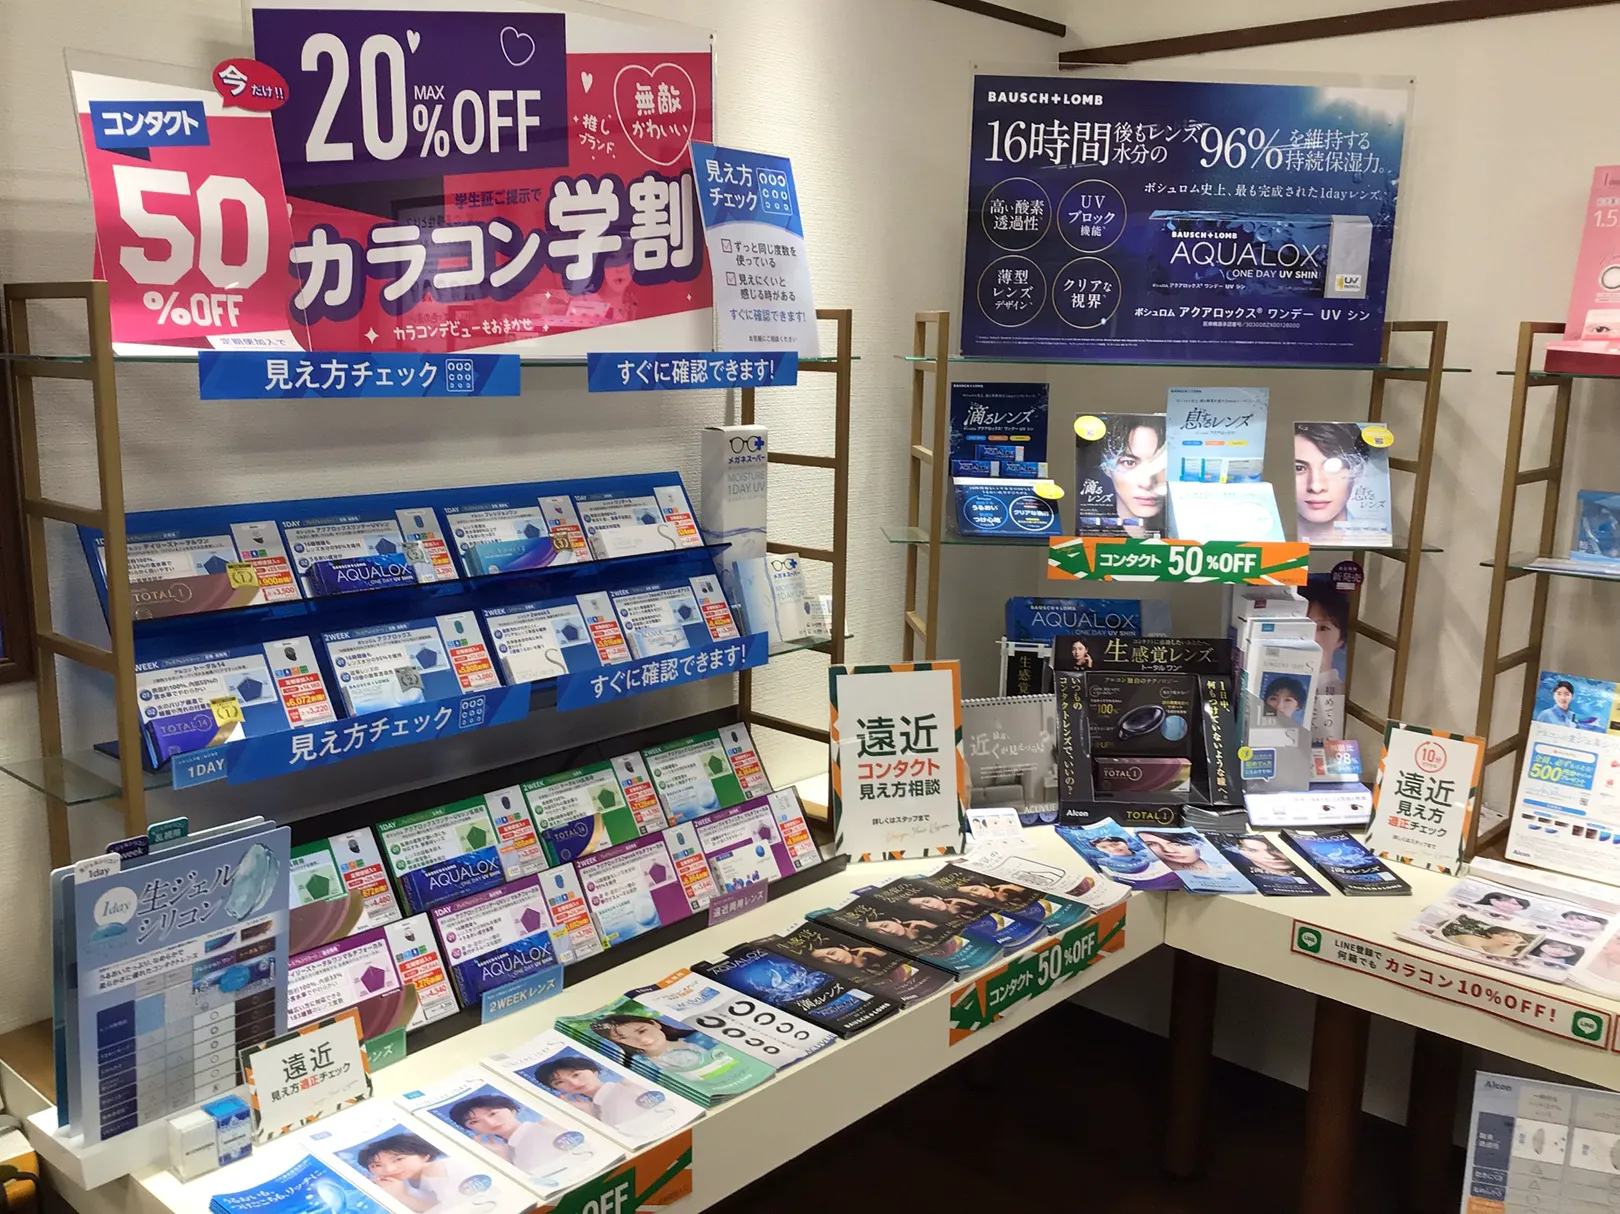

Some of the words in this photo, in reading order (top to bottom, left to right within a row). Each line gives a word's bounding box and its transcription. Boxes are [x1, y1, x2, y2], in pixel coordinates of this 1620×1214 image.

[414, 84, 445, 100] MAX
[634, 81, 682, 115] 無敵
[988, 91, 1103, 106] BAUSCH+LOMB
[101, 111, 200, 137] コンタクト
[583, 115, 610, 136] 推し
[632, 120, 688, 139] かわいい
[1113, 120, 1203, 144] 後もレンズ
[579, 133, 615, 154] ブランド
[985, 119, 1112, 166] 16時間
[1289, 128, 1371, 150] を維持する
[1112, 144, 1168, 164] 水分の
[1200, 126, 1283, 170] 96%
[1285, 150, 1386, 174] 持続保湿力。
[706, 159, 753, 188] 見え方
[455, 188, 541, 209] 学生証ご提示で
[709, 187, 758, 211] チェック
[990, 199, 1044, 215] 高い酸素
[1081, 195, 1106, 209] UV
[112, 163, 270, 290] 50
[993, 215, 1039, 231] 透過性
[1068, 211, 1116, 225] ブロック
[1080, 225, 1102, 237] 機能
[1171, 231, 1238, 239] BAUSCH+LOMB
[289, 174, 693, 310] カラコン学割
[734, 241, 797, 257] ずっと同じ度数を
[736, 254, 776, 268] 使っている
[1170, 241, 1321, 267] AQUALOX
[739, 273, 786, 287] 見えにくいと
[997, 269, 1029, 285] 薄型
[1232, 269, 1253, 279] ONE
[1256, 269, 1277, 279] DAY
[1279, 270, 1294, 279] UV
[1295, 270, 1318, 279] SHIN
[993, 286, 1033, 299] レンズ
[1063, 278, 1112, 293] クリアな
[1225, 282, 1235, 290] UV
[740, 288, 796, 302] 感じる時がある
[1071, 293, 1102, 309] 視界
[143, 290, 244, 328] %OFF
[995, 300, 1028, 311] デザイン
[1134, 307, 1176, 318] ボシュロム
[1268, 307, 1314, 320] ワンデー
[1320, 309, 1342, 321] UV
[1347, 310, 1371, 321] シン
[393, 317, 533, 343] カラコンデビューもおまかせ
[264, 357, 439, 391] 見え方チェック
[617, 356, 775, 385] すぐに確認できます!
[963, 403, 1035, 427] 滴るレンズ
[728, 454, 765, 465] メガネスーパー
[727, 472, 765, 482] MOISTURE
[728, 483, 751, 496] 1DAY
[753, 481, 766, 494] UV
[282, 520, 300, 529] 1DAY
[1100, 552, 1162, 569] コンタクト
[337, 562, 412, 583] AQUALOX
[610, 590, 630, 598] 2WEEK
[484, 607, 506, 617] 2WEEK
[1031, 612, 1136, 629] AQUALOX
[324, 632, 350, 642] 2WEEK
[1103, 638, 1214, 664] 生感覚レンズ
[591, 644, 746, 699] すぐに確認できます!
[1141, 664, 1166, 672] トータル
[1167, 664, 1182, 672] ワン
[1071, 677, 1083, 710] いつもの
[160, 721, 196, 734] TOTAL
[289, 706, 453, 764] 見え方チェック
[856, 713, 939, 759] 遠近
[644, 747, 662, 757] 2WEEK
[188, 758, 226, 778] 1DAY
[858, 758, 940, 780] コンタクト
[1104, 769, 1130, 778] TOTAL
[523, 780, 545, 791] 2WEEK
[859, 779, 941, 801] 見え方相談
[1394, 770, 1455, 807] 遠近
[872, 814, 930, 826] 詳しくはスタッフまで
[1066, 809, 1089, 818] Alcon
[1127, 810, 1159, 820] TOTAL
[1396, 800, 1445, 824] 見え方
[379, 821, 396, 831] 1DAY
[695, 817, 712, 828] 2WEEK
[1388, 815, 1447, 838] 適正チェック
[554, 829, 578, 842] TOTAL
[577, 856, 597, 868] 2WEEK
[88, 866, 111, 879] 1day
[429, 856, 499, 890] AQUALOX
[137, 865, 239, 917] 生ジェル
[103, 898, 131, 918] 1day
[434, 906, 452, 917] 1DAY
[137, 898, 224, 945] シリコン
[1303, 934, 1317, 945] LINE
[1334, 938, 1382, 960] LINE登録で
[482, 942, 550, 981] AQUALOX
[1337, 950, 1377, 970] 何箱でも
[989, 971, 1035, 1007] コンタクト
[1580, 1019, 1598, 1030] LINE
[282, 1041, 334, 1083] 遠近
[271, 1062, 351, 1103] 見え方適正チェック
